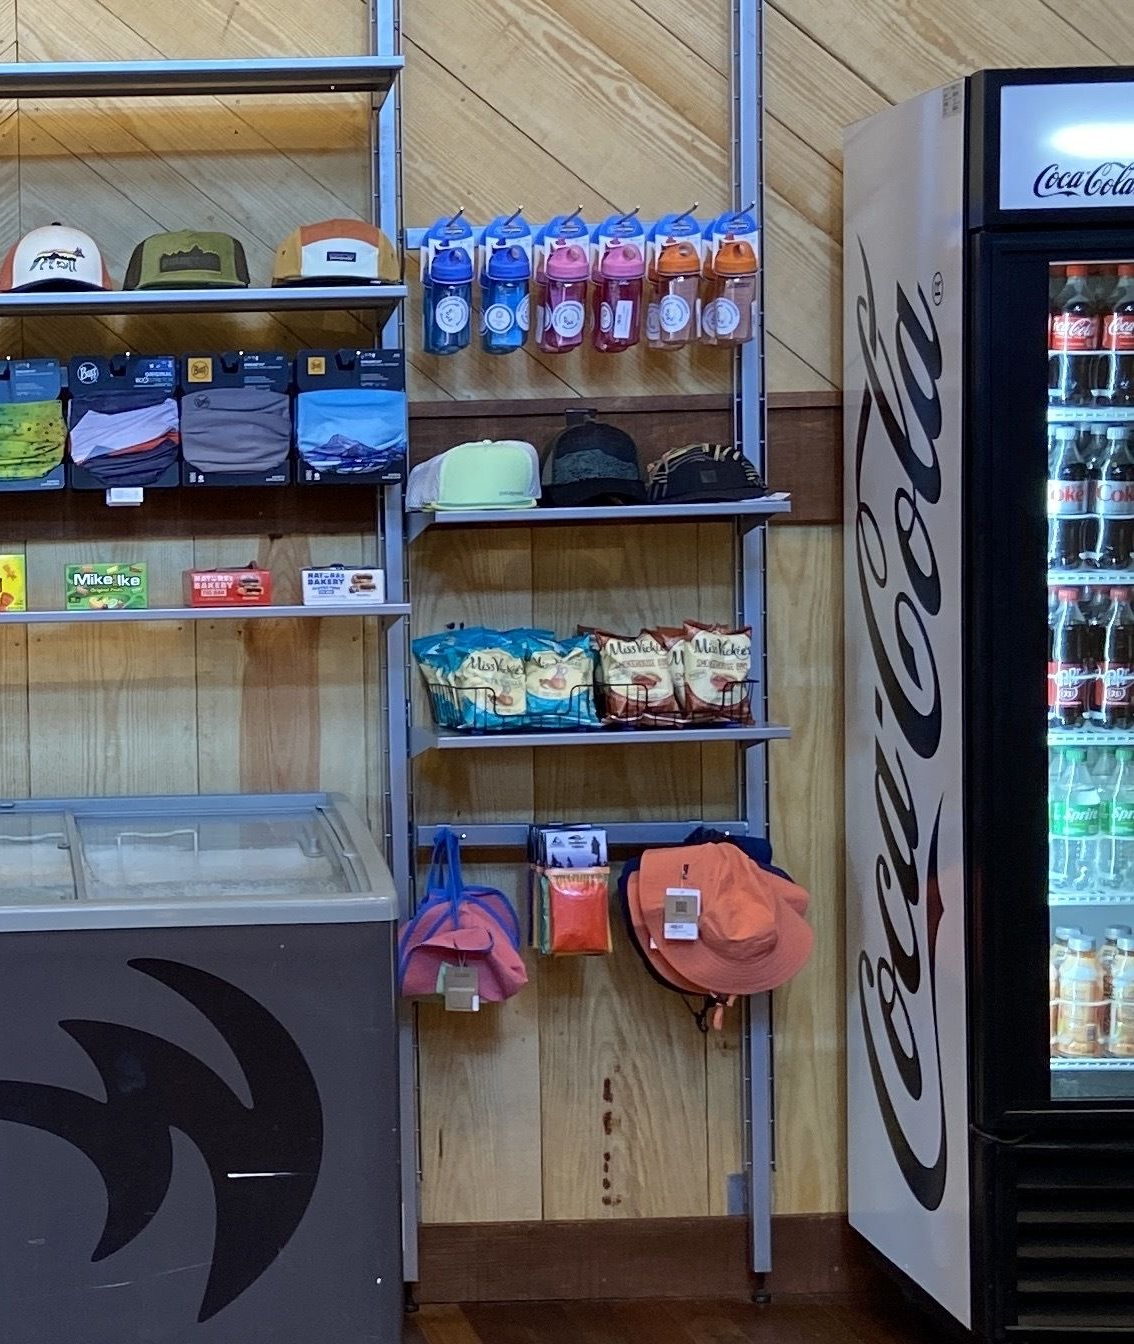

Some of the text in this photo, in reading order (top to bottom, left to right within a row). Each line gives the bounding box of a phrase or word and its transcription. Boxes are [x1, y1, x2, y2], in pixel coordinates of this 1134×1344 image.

[73, 573, 141, 587] Mike Ike
[856, 233, 947, 1211] Coca-Cola
